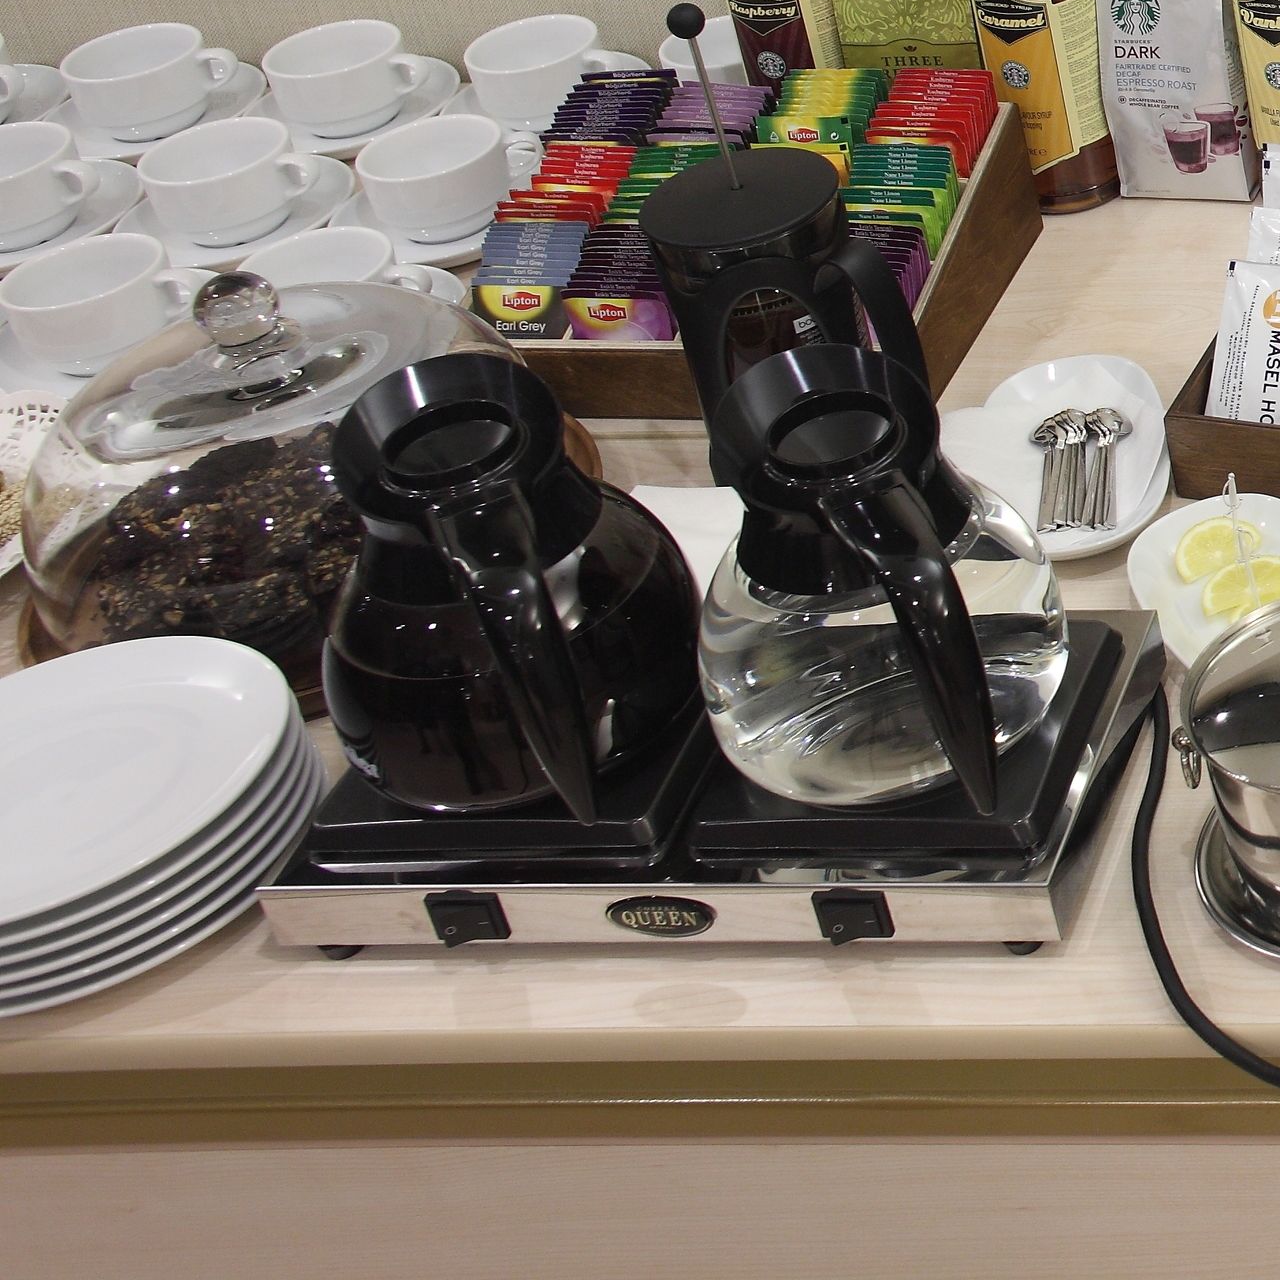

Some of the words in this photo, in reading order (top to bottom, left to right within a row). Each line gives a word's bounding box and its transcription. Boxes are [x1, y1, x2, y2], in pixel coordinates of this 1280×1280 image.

[730, 1, 796, 18] Raspberry
[978, 9, 1045, 28] Caramel
[1114, 45, 1161, 59] DARK
[881, 56, 944, 67] THREE
[1158, 64, 1191, 73] CERTIFIED
[1117, 78, 1165, 88] ESPRESSO
[1168, 81, 1197, 91] ROAST
[505, 296, 538, 307] Lipton
[590, 308, 624, 318] Lipton
[496, 320, 516, 331] Earl
[519, 321, 546, 333] Grey
[621, 910, 697, 928] QUEEN
